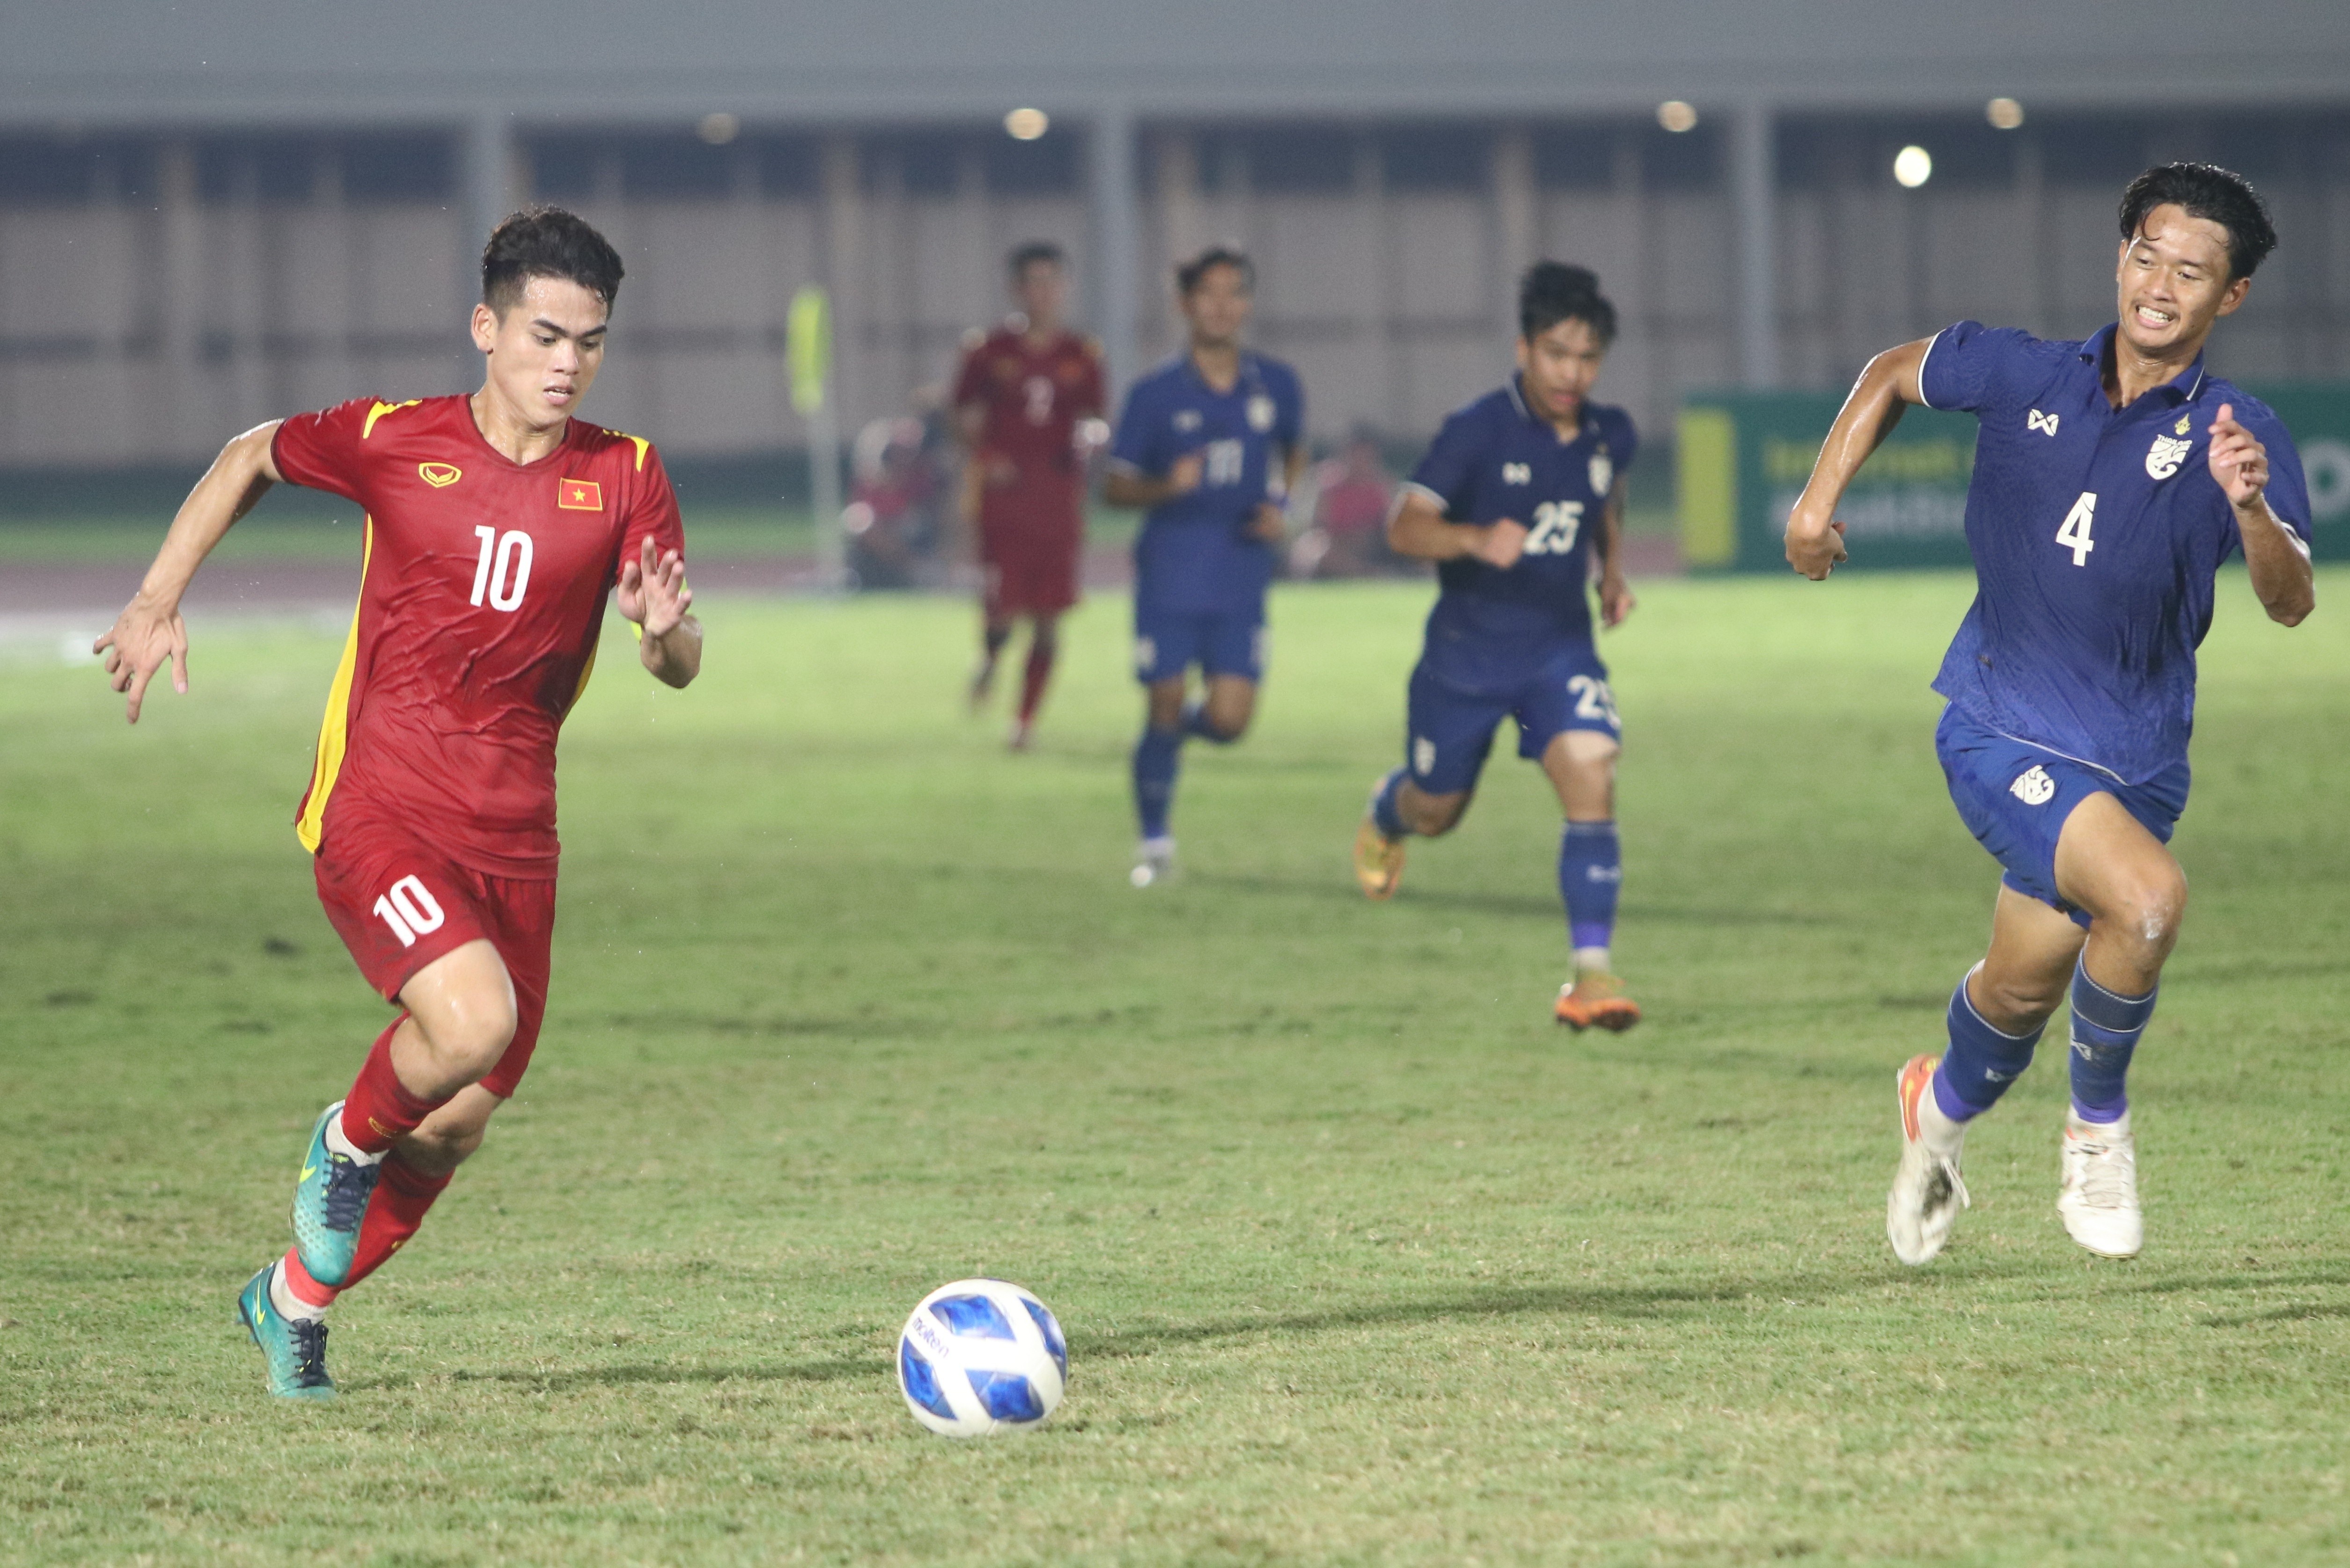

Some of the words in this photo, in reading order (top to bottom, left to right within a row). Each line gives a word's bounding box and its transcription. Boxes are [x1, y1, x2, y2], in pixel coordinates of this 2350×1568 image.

[1522, 500, 1585, 556] 25
[2056, 491, 2097, 567] 4
[470, 525, 533, 612] 10
[373, 874, 445, 948] 10
